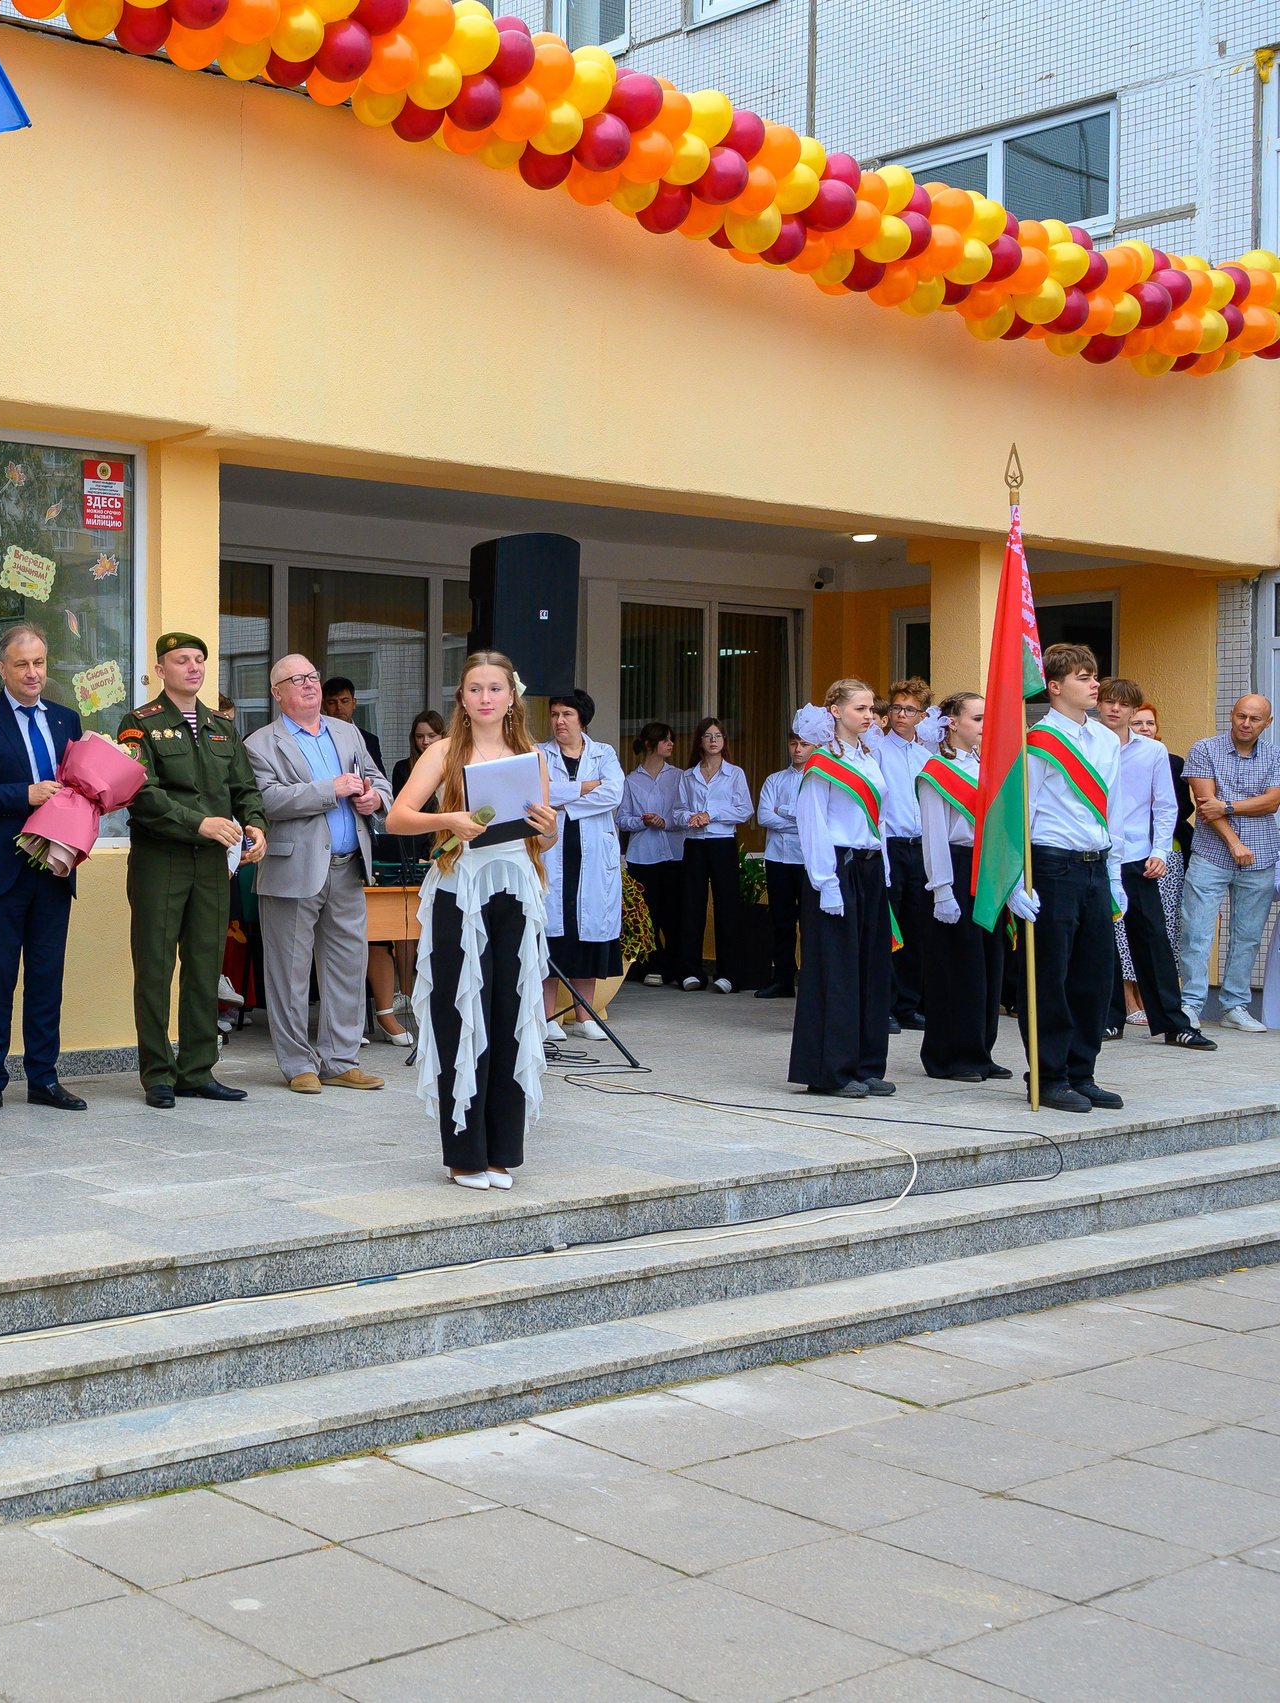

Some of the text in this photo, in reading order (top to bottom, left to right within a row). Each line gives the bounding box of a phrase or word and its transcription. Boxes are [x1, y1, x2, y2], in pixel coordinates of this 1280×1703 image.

[87, 496, 121, 509] ЗДЕСЬ
[86, 519, 122, 527] МИЛИЦИЮ
[14, 550, 44, 570] Вперёд
[12, 562, 48, 581] знаниям!
[86, 668, 108, 681] Снова
[90, 674, 116, 691] школу!
